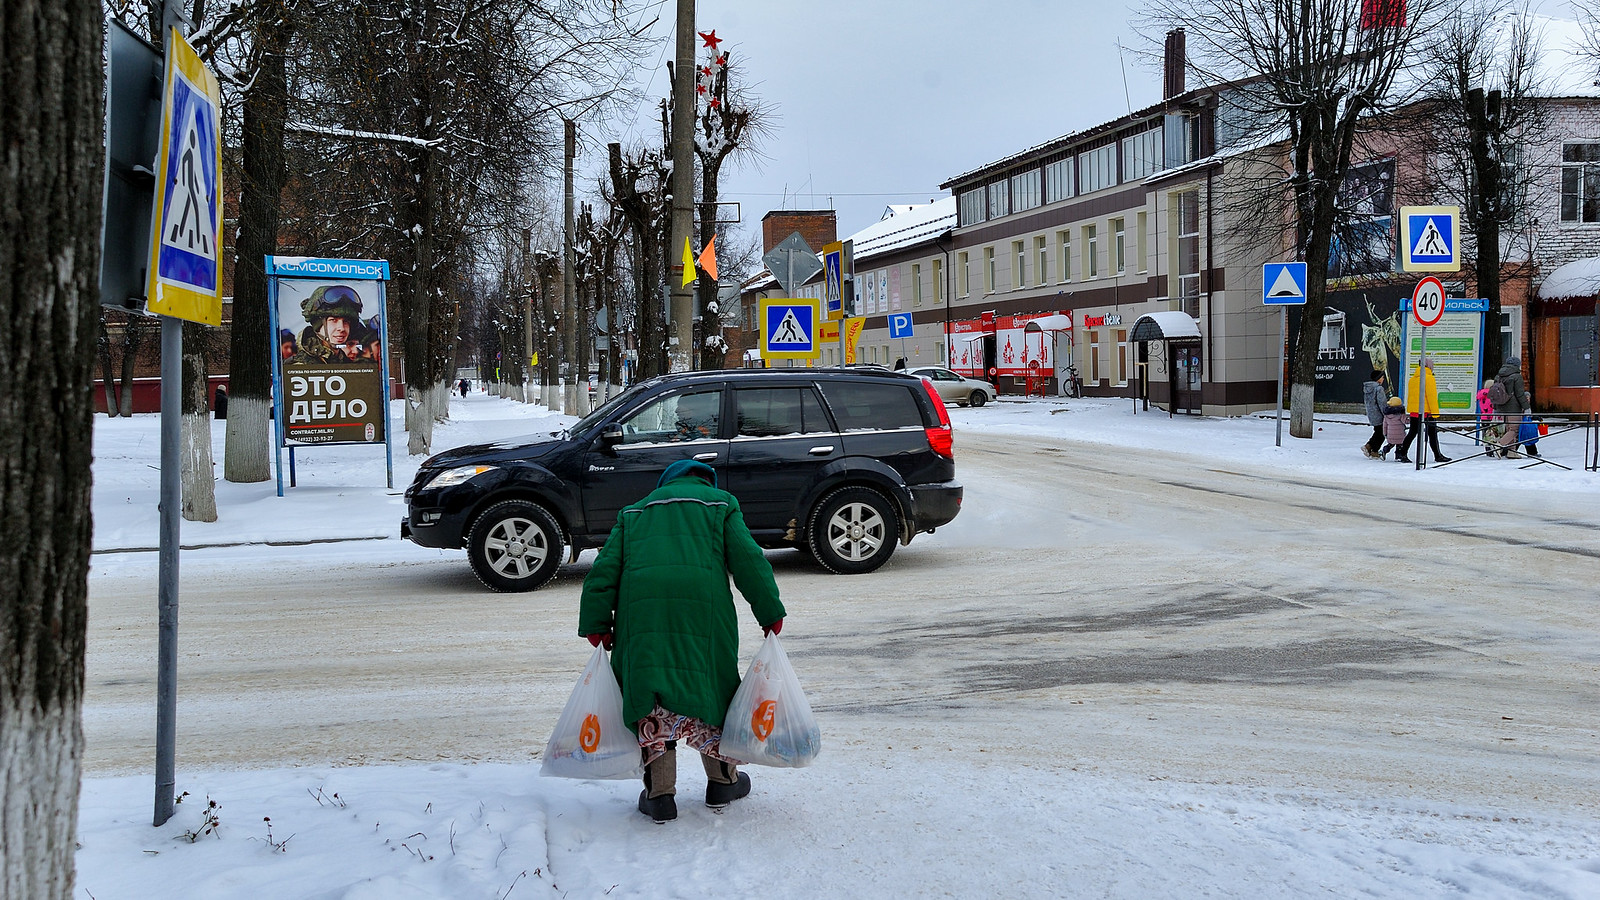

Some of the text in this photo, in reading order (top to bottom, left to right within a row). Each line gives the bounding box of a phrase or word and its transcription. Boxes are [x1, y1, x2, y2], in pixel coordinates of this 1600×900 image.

[1418, 292, 1438, 311] 40
[893, 316, 908, 336] P
[290, 375, 346, 397] ЭТО
[289, 398, 368, 424] ДЕЛО
[290, 428, 335, 436] CONTRACT.MIL.RU
